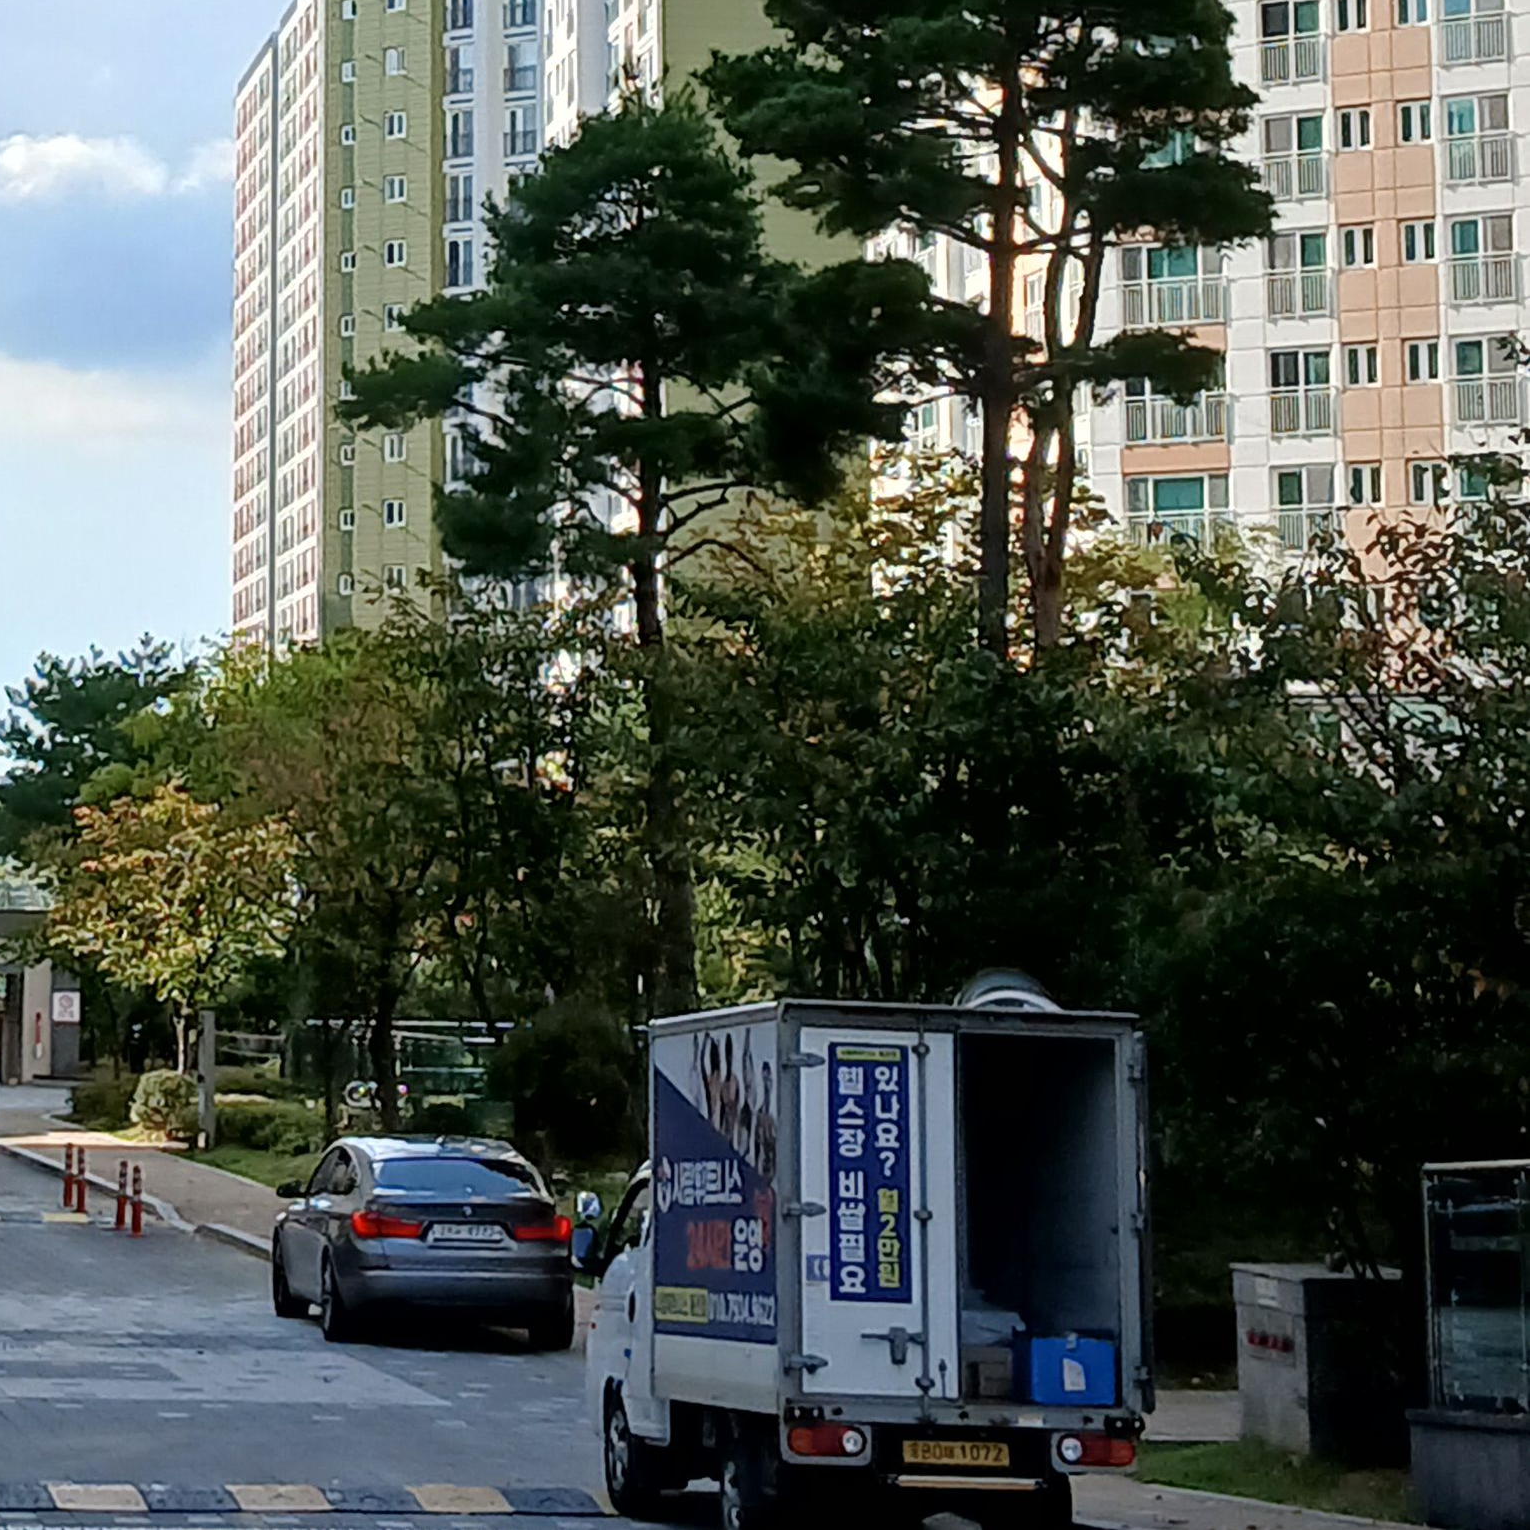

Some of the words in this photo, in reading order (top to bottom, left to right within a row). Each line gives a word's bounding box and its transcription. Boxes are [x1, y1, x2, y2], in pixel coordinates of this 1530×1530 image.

[836, 1065, 866, 1158] 헬스장
[873, 1065, 901, 1177] 있나요?
[733, 1218, 764, 1273] 운영
